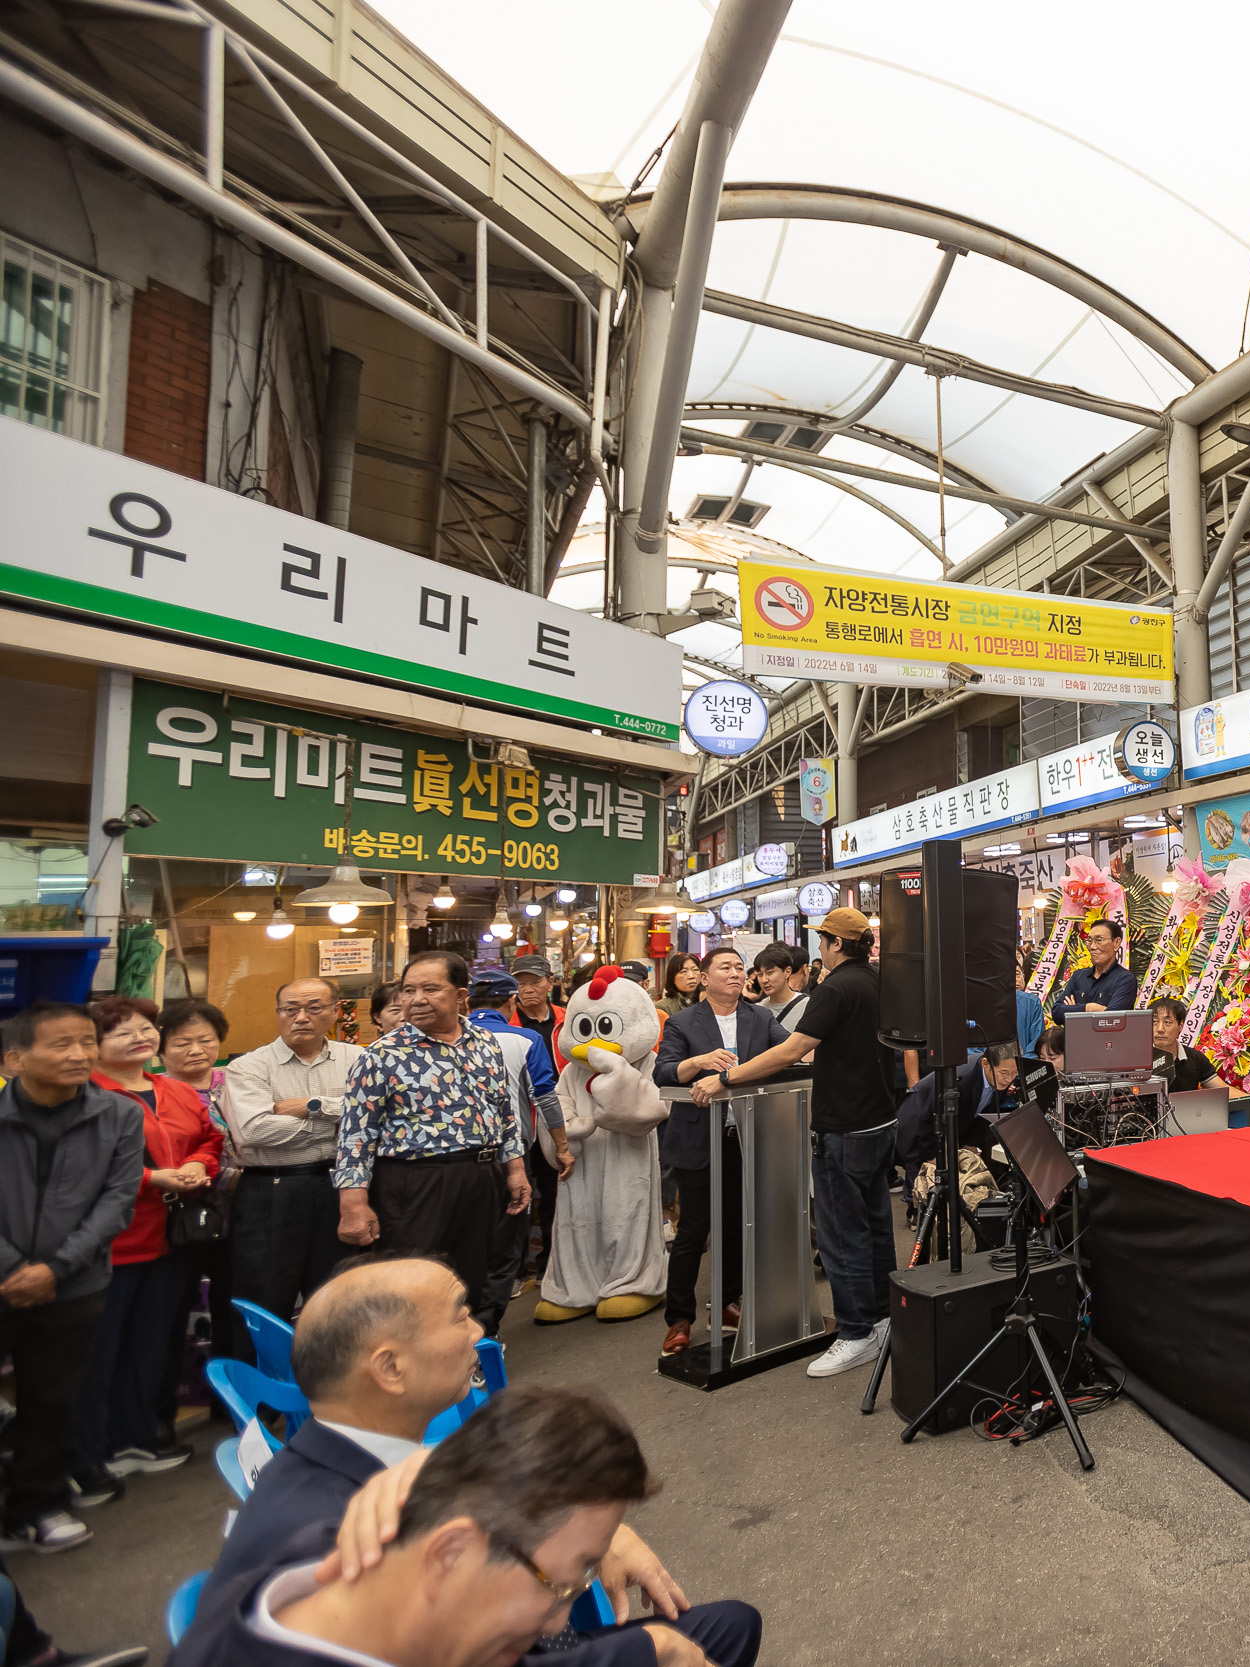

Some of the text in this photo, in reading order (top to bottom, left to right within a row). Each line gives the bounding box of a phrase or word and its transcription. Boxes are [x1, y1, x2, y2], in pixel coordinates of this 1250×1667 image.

[824, 586, 1082, 636] 자양전통시장 금연구역 지정
[767, 632, 799, 643] Smoking
[825, 621, 1166, 670] 통행로에서 흡연 시, 10만원의 과태료가 부과됩니다.
[804, 658, 838, 671] 2022년
[840, 660, 855, 673] 6월
[858, 661, 878, 674] 14일
[1028, 677, 1045, 688] 12일
[1093, 681, 1118, 692] 2022년
[1120, 683, 1131, 694] 8월
[702, 695, 752, 715] 진선명
[613, 711, 668, 737] T.444-0772
[710, 714, 744, 732] 청과
[717, 739, 736, 750] 과일
[1135, 731, 1164, 748] 오늘
[1135, 748, 1164, 765] 생선
[1143, 767, 1158, 777] 생선
[813, 776, 821, 787] 6
[438, 833, 560, 871] 455-9063
[808, 888, 824, 897] 삼호
[1025, 1065, 1048, 1085] SHURE
